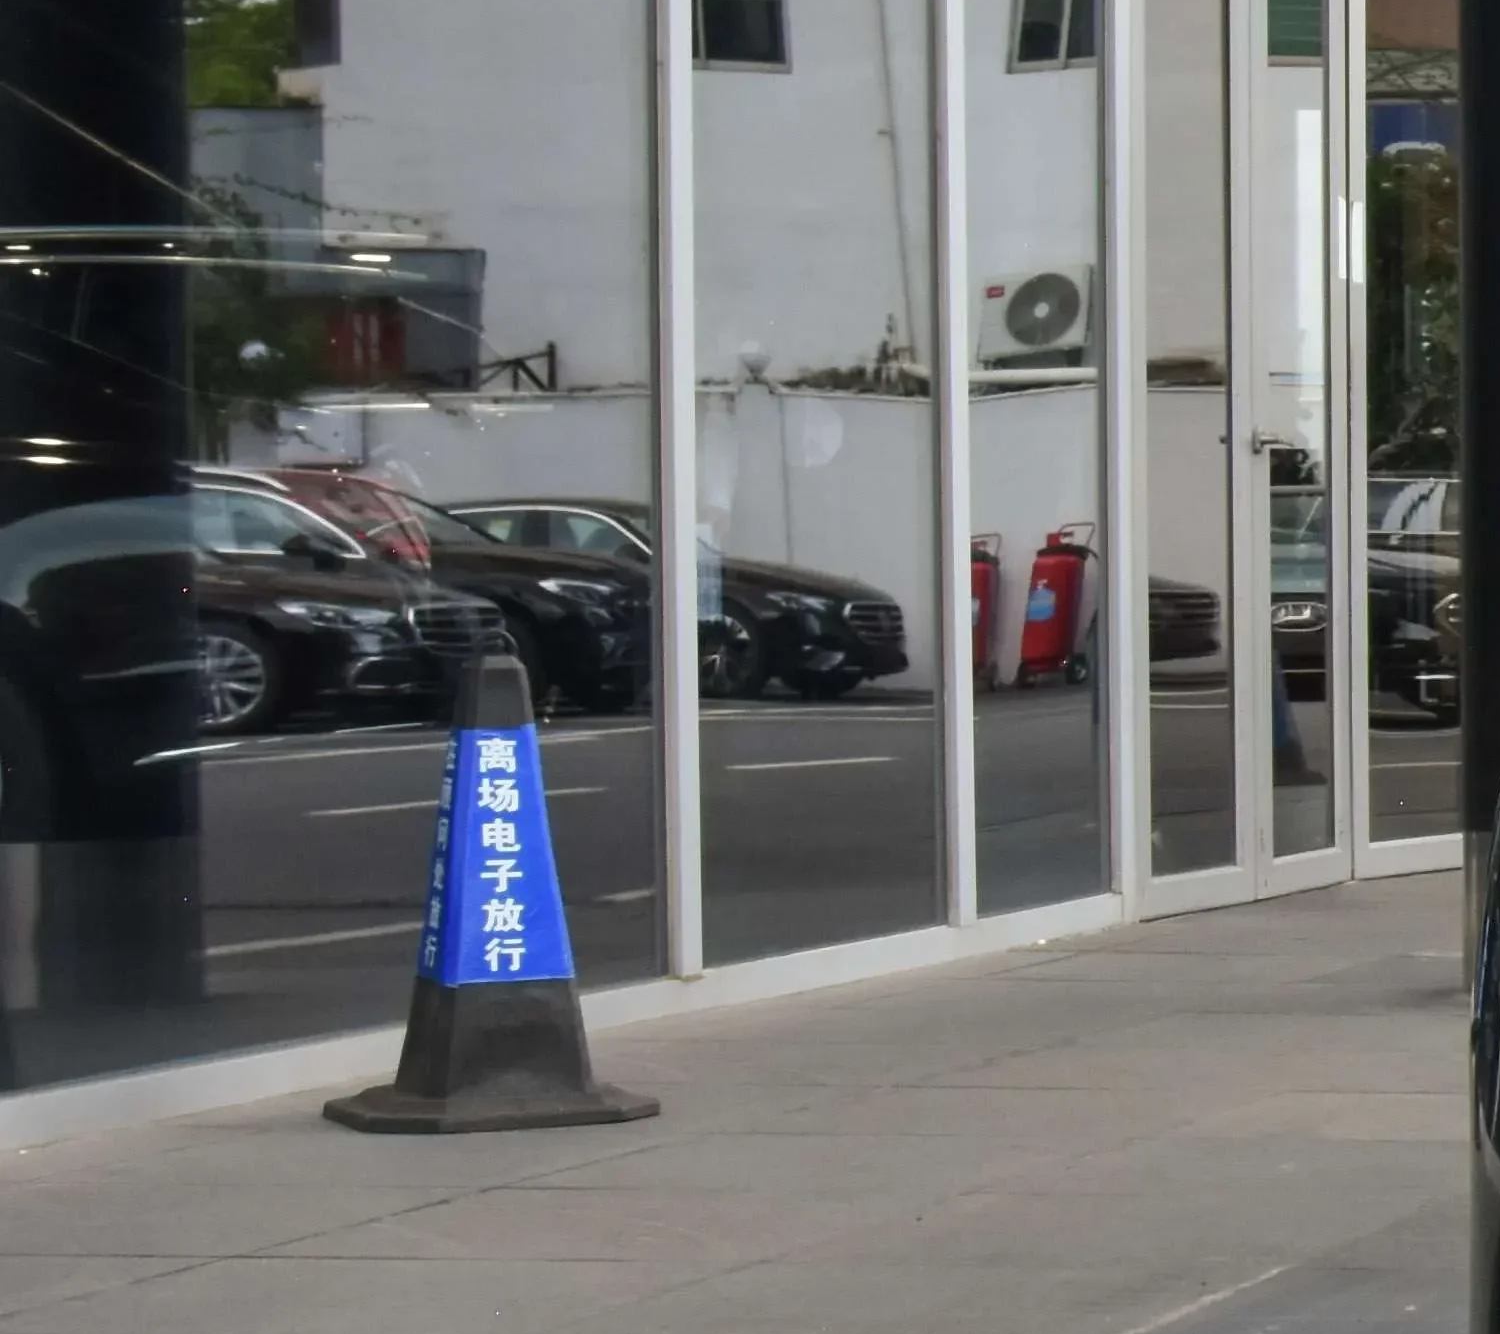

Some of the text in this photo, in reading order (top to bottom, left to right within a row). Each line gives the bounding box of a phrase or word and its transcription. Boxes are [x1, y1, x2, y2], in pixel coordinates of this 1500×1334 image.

[476, 737, 527, 972] 离场电子放行
